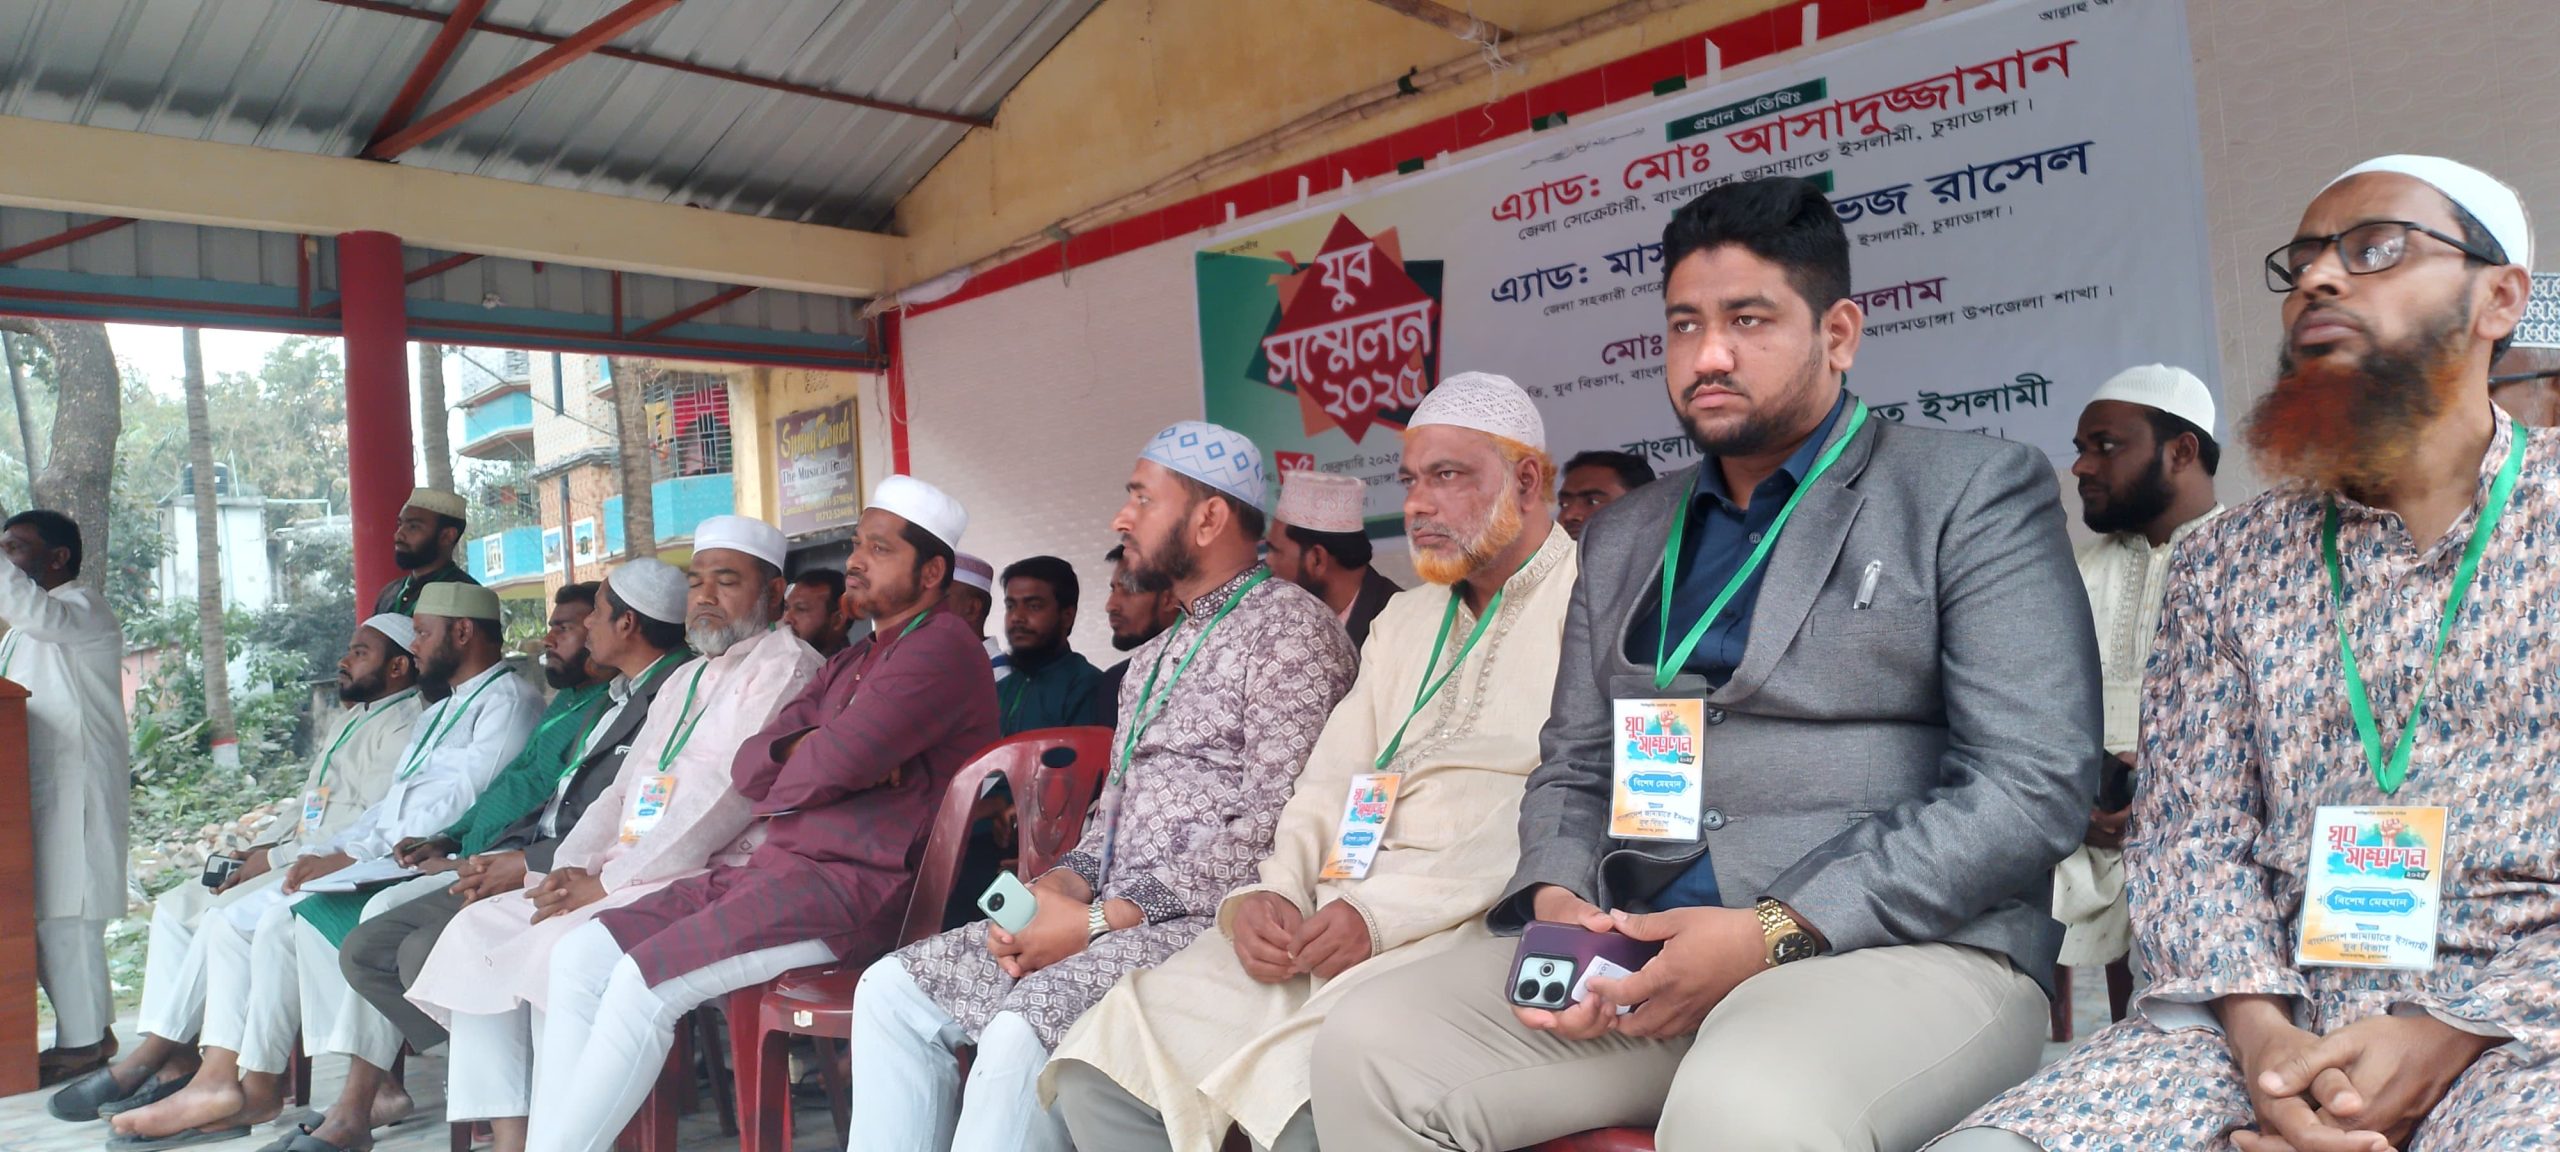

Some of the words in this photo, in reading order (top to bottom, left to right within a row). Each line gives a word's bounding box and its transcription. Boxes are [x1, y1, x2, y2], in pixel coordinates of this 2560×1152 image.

[1623, 143, 1710, 190] মোঃ
[1725, 40, 2078, 155] আসাদুজ্জামান
[1693, 110, 1734, 130] প্রধান
[1925, 141, 2096, 204] রাসেল
[1518, 219, 1557, 240] জেলা
[1317, 240, 1374, 311] যুব
[1543, 301, 1575, 317] জেলা
[1262, 299, 1433, 386] সম্মেলন
[1553, 381, 1573, 397] যুব
[1862, 311, 1955, 338] আলমডাঙ্গা
[1962, 295, 2045, 320] উপজেলা
[2053, 285, 2099, 304] শাখা
[1602, 334, 1664, 365] মোঃ
[1322, 364, 1425, 419] ২০২৫
[1917, 373, 2053, 423] ইসলামী
[782, 471, 795, 485] The
[798, 460, 828, 481] Musical
[1369, 452, 1400, 467] ২০২৫
[1625, 716, 1645, 740] যুব
[1638, 736, 1692, 757] সম্মেলন
[2327, 825, 2357, 852] যুব
[2345, 847, 2427, 872] সম্মেলন
[2334, 894, 2365, 906] বিশেষ
